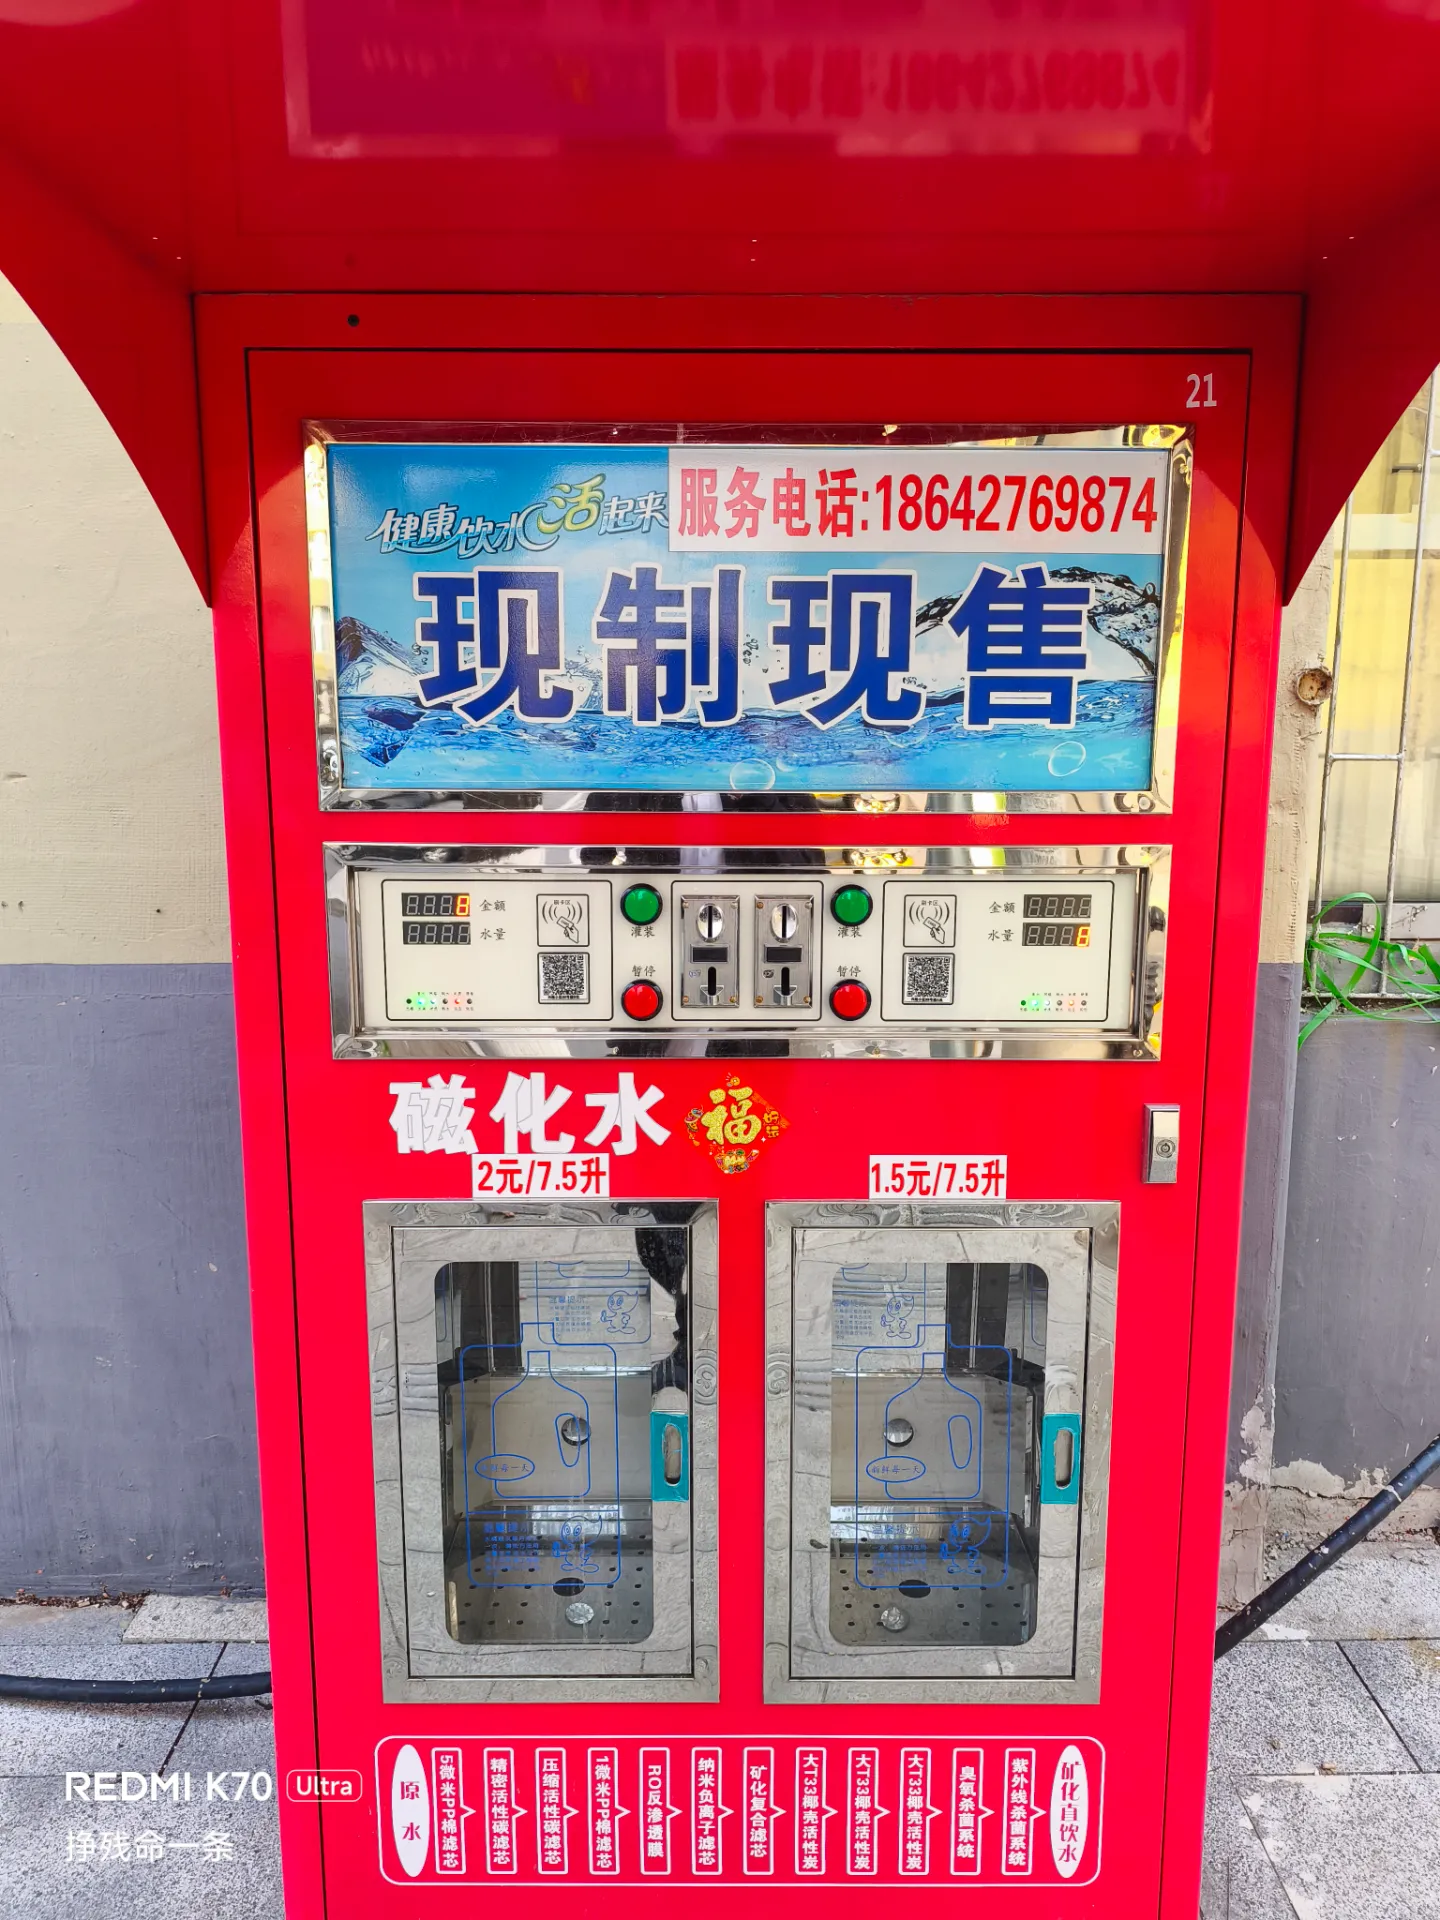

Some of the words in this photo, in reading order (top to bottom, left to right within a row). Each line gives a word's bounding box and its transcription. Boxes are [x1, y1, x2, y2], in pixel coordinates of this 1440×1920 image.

[1186, 373, 1218, 409] 21
[365, 473, 670, 559] 健康饮水活起来
[677, 465, 1159, 539] 服务电话:18642769874
[415, 564, 1094, 729] 现制现售
[479, 898, 507, 912] 金额
[479, 927, 507, 941] 水量
[631, 925, 656, 938] 灌装
[837, 925, 863, 938] 灌装
[987, 928, 1014, 942] 水量
[988, 901, 1016, 914] 金额
[631, 963, 656, 977] 暂停
[836, 964, 862, 978] 暂停
[389, 1072, 671, 1156] 磁化水
[701, 1086, 762, 1146] 福
[477, 1158, 607, 1195] 2元/7.5升
[870, 1160, 1006, 1197] 1.5元/7.5升
[400, 1780, 422, 1841] 原水
[439, 1755, 459, 1868] 5微米PP棉滤芯
[490, 1758, 512, 1865] 精密活性碳滤芯
[542, 1758, 562, 1865] 压缩活性碳滤芯
[594, 1756, 613, 1868] 1微米PP棉滤芯
[647, 1765, 665, 1858] RO反渗透膜
[697, 1758, 716, 1866] 纳米负离子滤芯
[749, 1765, 768, 1857] 矿化复合滤芯
[802, 1754, 820, 1869] 大T33椰壳活性炭
[854, 1754, 872, 1869] 大T33椰壳活性炭
[906, 1754, 924, 1869] 大T33椰壳活性炭
[956, 1765, 976, 1858] 臭氧杀菌系统
[1008, 1758, 1030, 1866] 紫外线杀菌系统
[1057, 1760, 1081, 1863] 矿化直饮水
